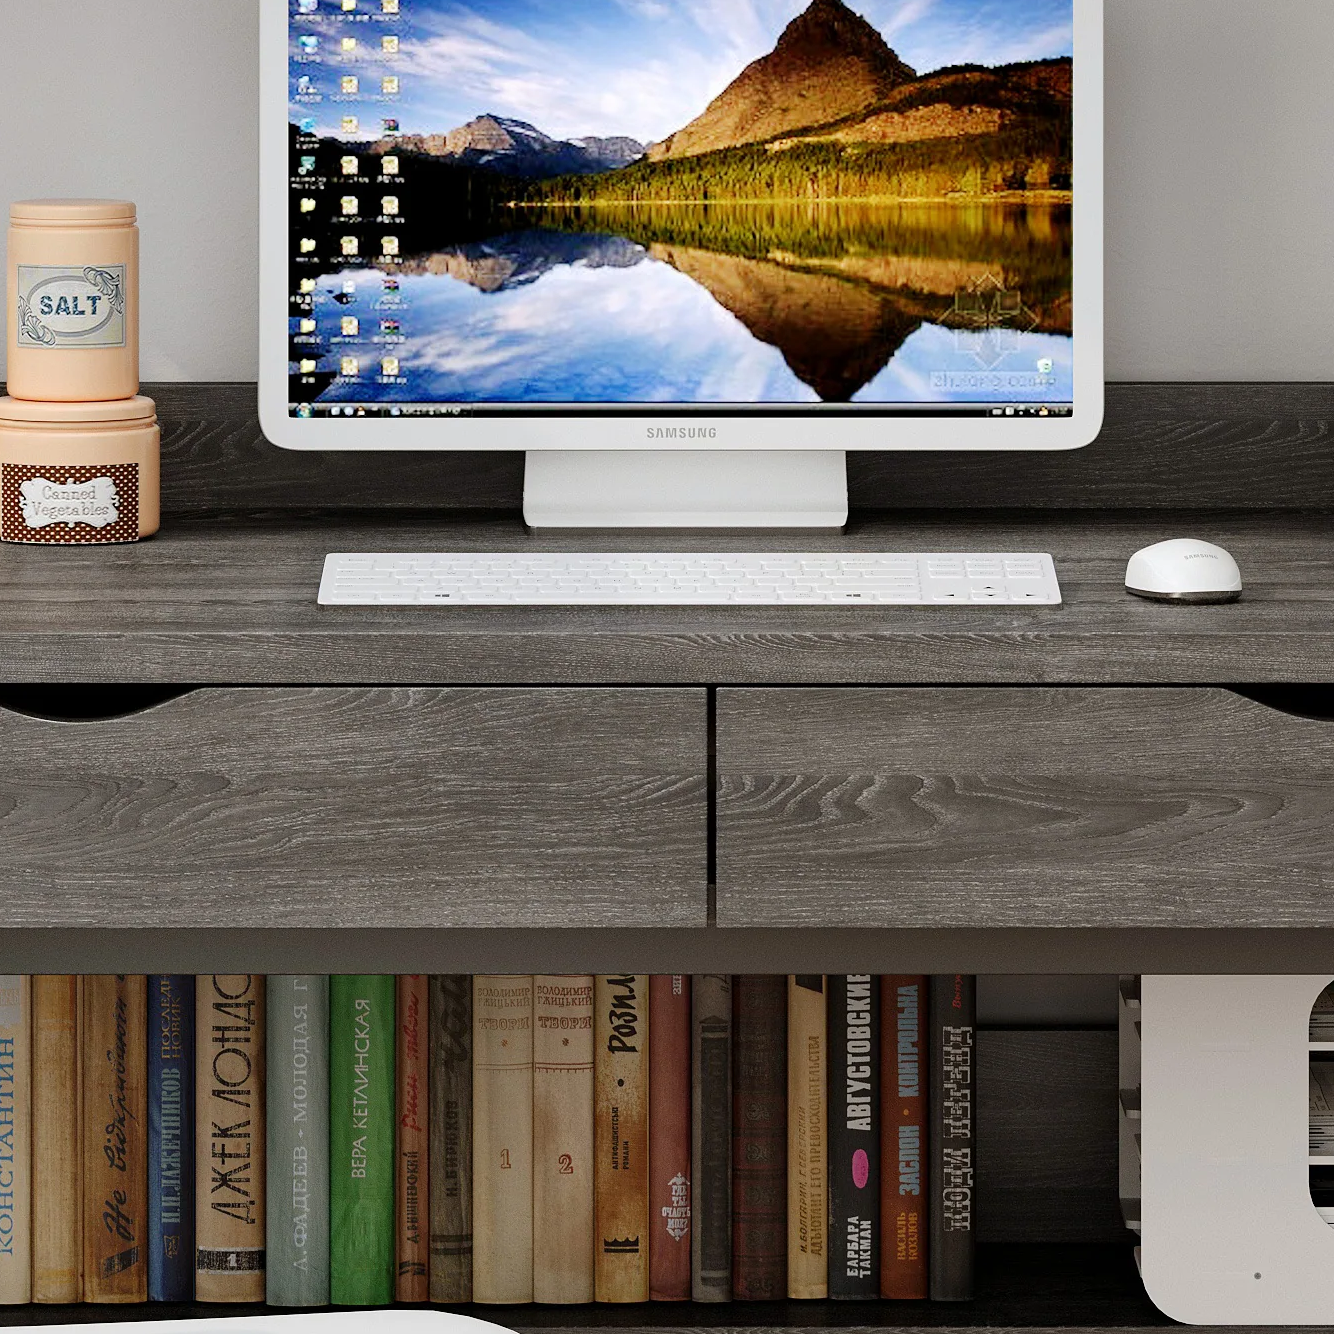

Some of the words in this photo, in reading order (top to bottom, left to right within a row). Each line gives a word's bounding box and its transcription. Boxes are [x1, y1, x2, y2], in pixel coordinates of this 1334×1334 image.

[38, 293, 103, 318] SALT
[646, 427, 717, 439] SAMSUNG
[31, 501, 110, 519] Vegetables
[41, 485, 97, 501] Canned
[477, 987, 530, 998] ВОЛОДИМИР
[537, 985, 592, 997] ВОЛОДИМИР
[537, 996, 593, 1008] ГЖИЦЬКИЙ
[170, 997, 182, 1058] НОВИК
[478, 1017, 530, 1031] ТВОРИ
[537, 1016, 592, 1029] ТВОРИ
[897, 984, 919, 1097] КОНТРОЛЬНА
[292, 1004, 310, 1122] МОЛОДАЯ
[352, 999, 370, 1128] КЕТЛИНСКАЯ
[942, 1026, 973, 1138] ЛЕГЕНД
[210, 1119, 255, 1225] ДЖЕК
[351, 1136, 367, 1178] ВЕРА
[500, 1149, 512, 1169] 1
[558, 1153, 574, 1175] 2
[809, 1167, 823, 1189] ЕГО
[898, 1125, 920, 1196] ЗАСЛОН
[942, 1148, 973, 1232] ЛЮДИ
[847, 1216, 859, 1277] БАРБАРА
[859, 1220, 872, 1278] ТАКМАН
[896, 1212, 907, 1261] ВАСИЛЬ
[907, 1212, 918, 1261] КОЗЛОВ
